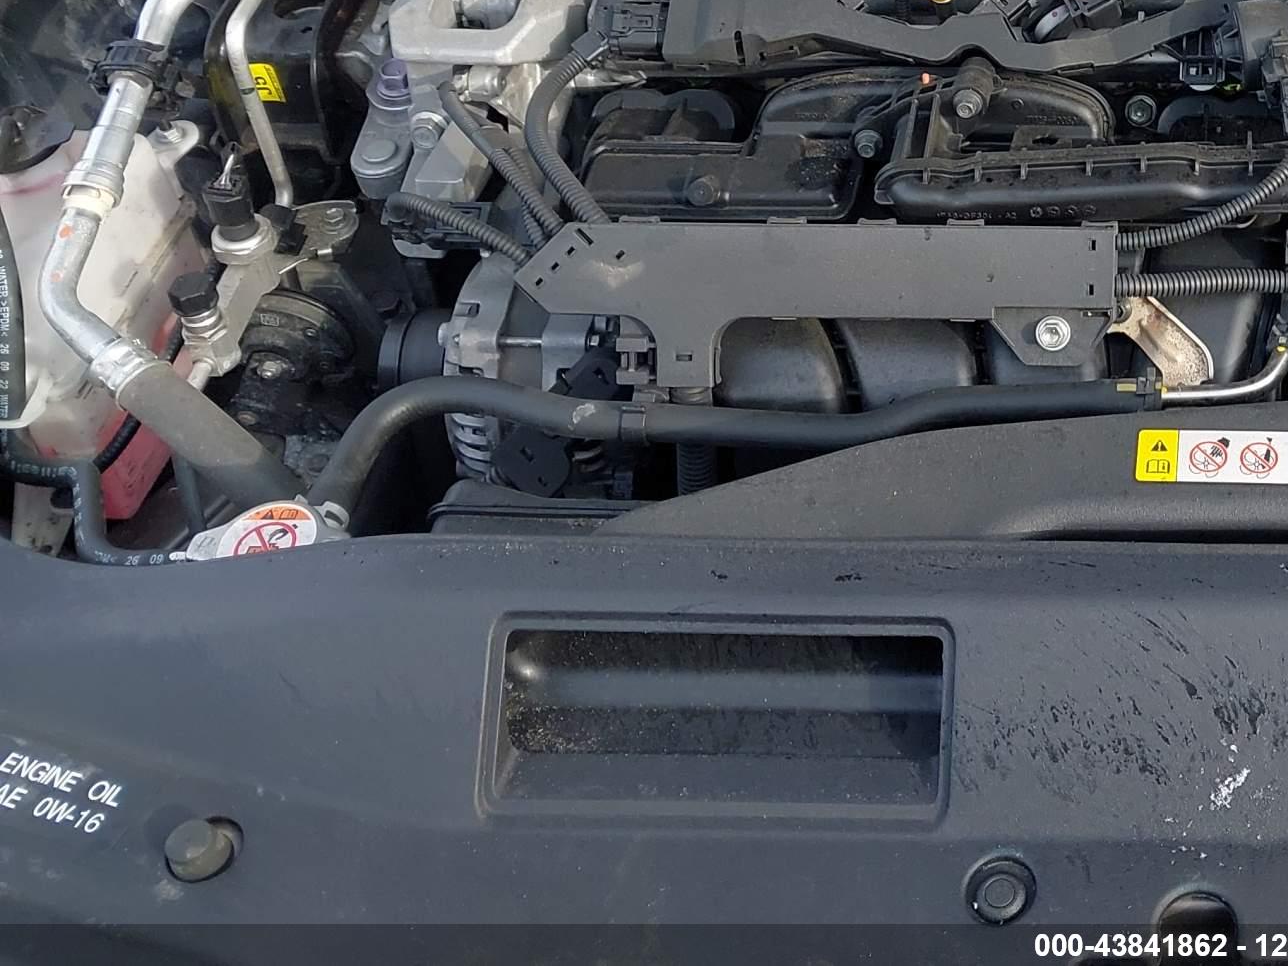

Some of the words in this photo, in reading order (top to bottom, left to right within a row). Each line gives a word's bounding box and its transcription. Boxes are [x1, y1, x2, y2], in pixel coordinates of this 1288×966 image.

[0, 751, 84, 793] ENGINE
[87, 780, 124, 808] OIL
[33, 796, 105, 833] 0W-16
